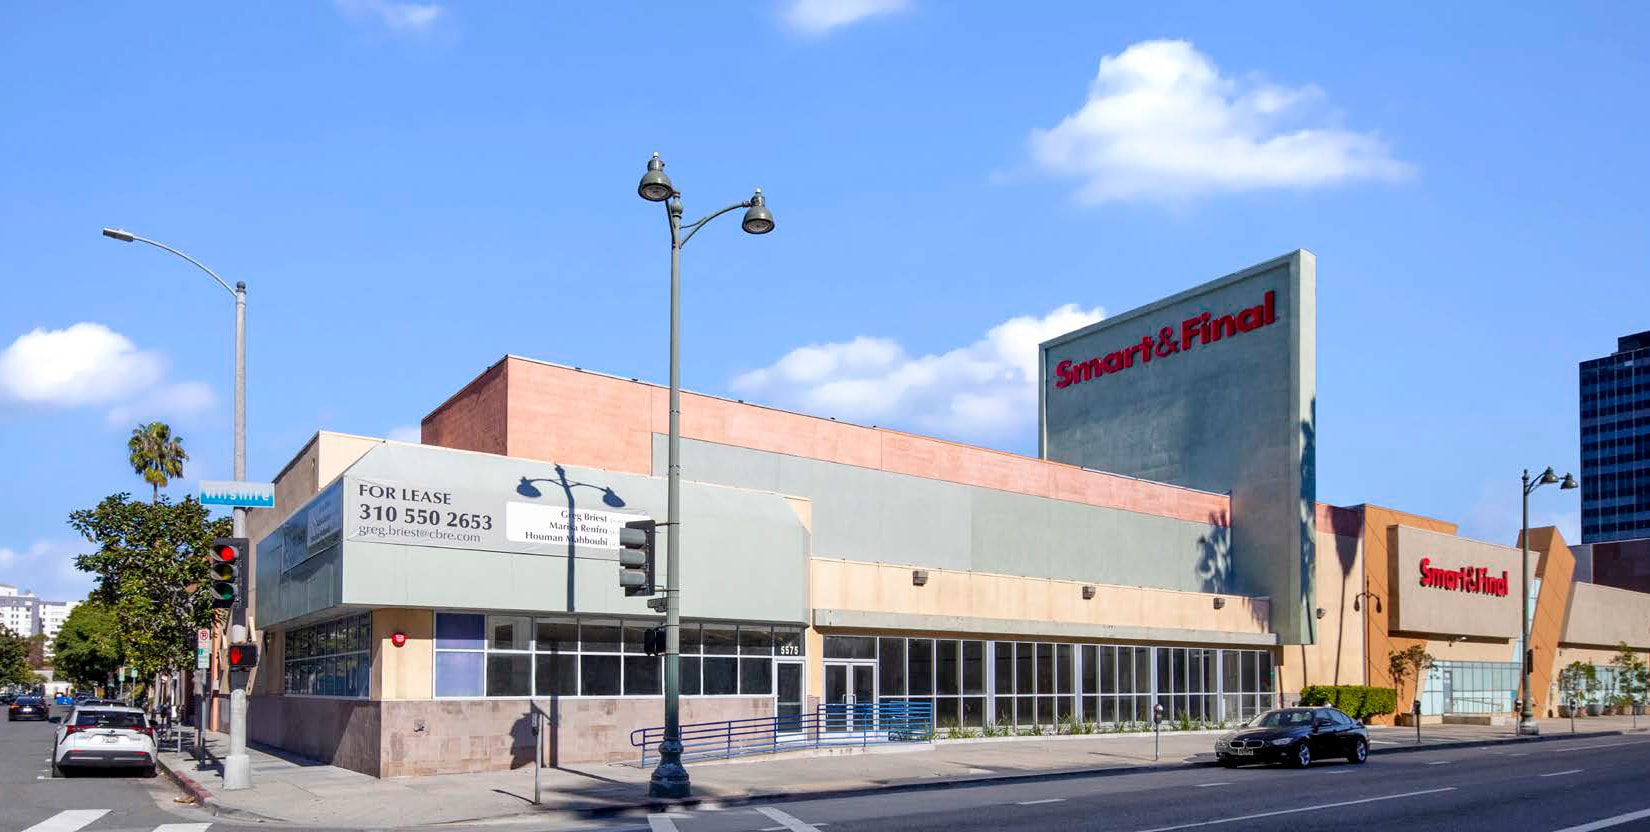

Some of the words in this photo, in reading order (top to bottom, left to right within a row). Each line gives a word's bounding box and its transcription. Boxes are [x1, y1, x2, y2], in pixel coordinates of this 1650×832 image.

[1055, 290, 1275, 389] Smart&Final
[359, 484, 396, 500] FOR
[402, 488, 452, 505] LEASE
[359, 503, 398, 522] 310
[404, 508, 440, 526] 550
[446, 511, 493, 531] 2653
[560, 510, 582, 522] Greg
[584, 513, 608, 523] Briest
[359, 525, 481, 543] greg.briest@cbre.com
[525, 531, 563, 543] Houman
[580, 524, 608, 535] Renfro
[1419, 557, 1508, 597] Smart&Final
[780, 645, 799, 656] 5575
